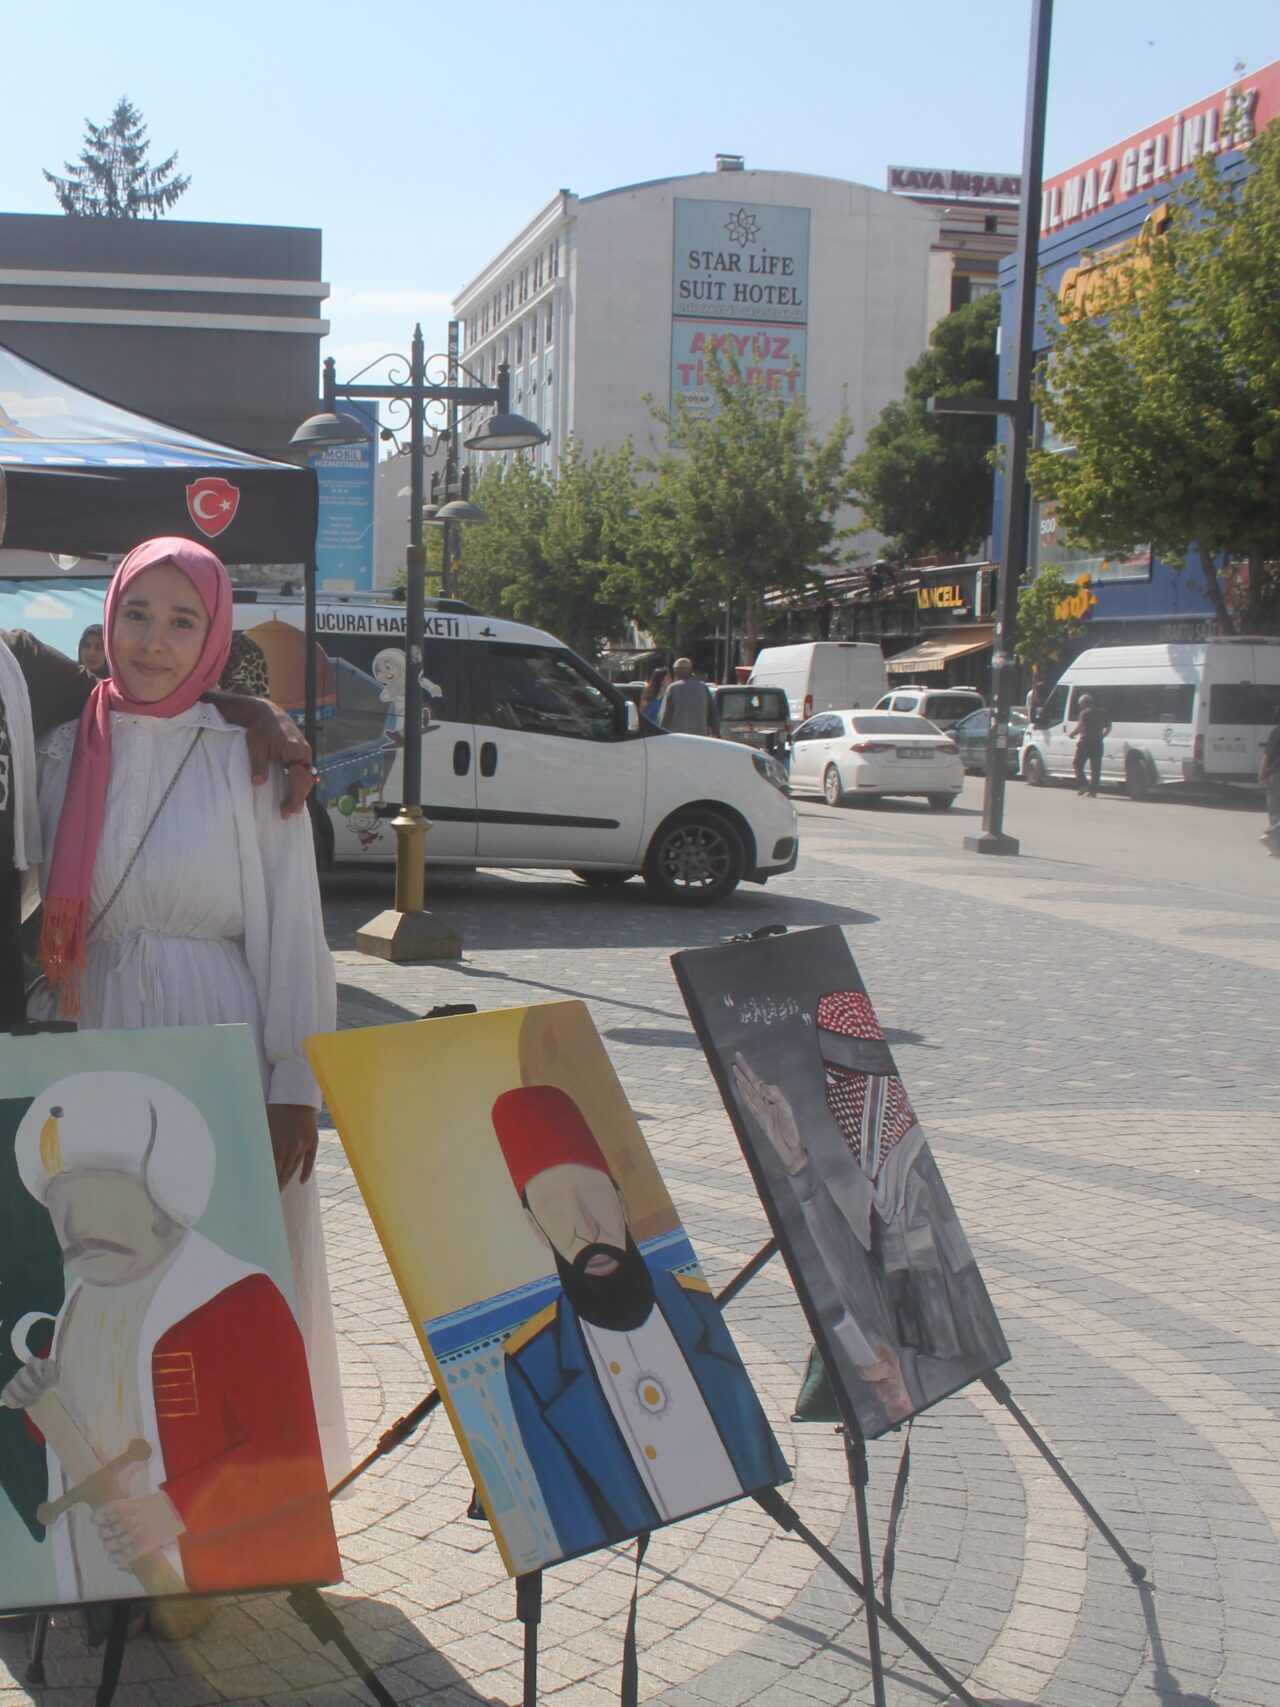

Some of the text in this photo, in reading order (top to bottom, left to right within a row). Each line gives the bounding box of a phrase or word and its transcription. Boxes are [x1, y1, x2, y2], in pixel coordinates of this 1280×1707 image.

[891, 169, 945, 190] KAYA
[1040, 159, 1116, 231] ILMAZ
[688, 247, 794, 276] STAR LİFE
[679, 273, 802, 306] SUİT HOTEL
[316, 613, 373, 632] UCURAT
